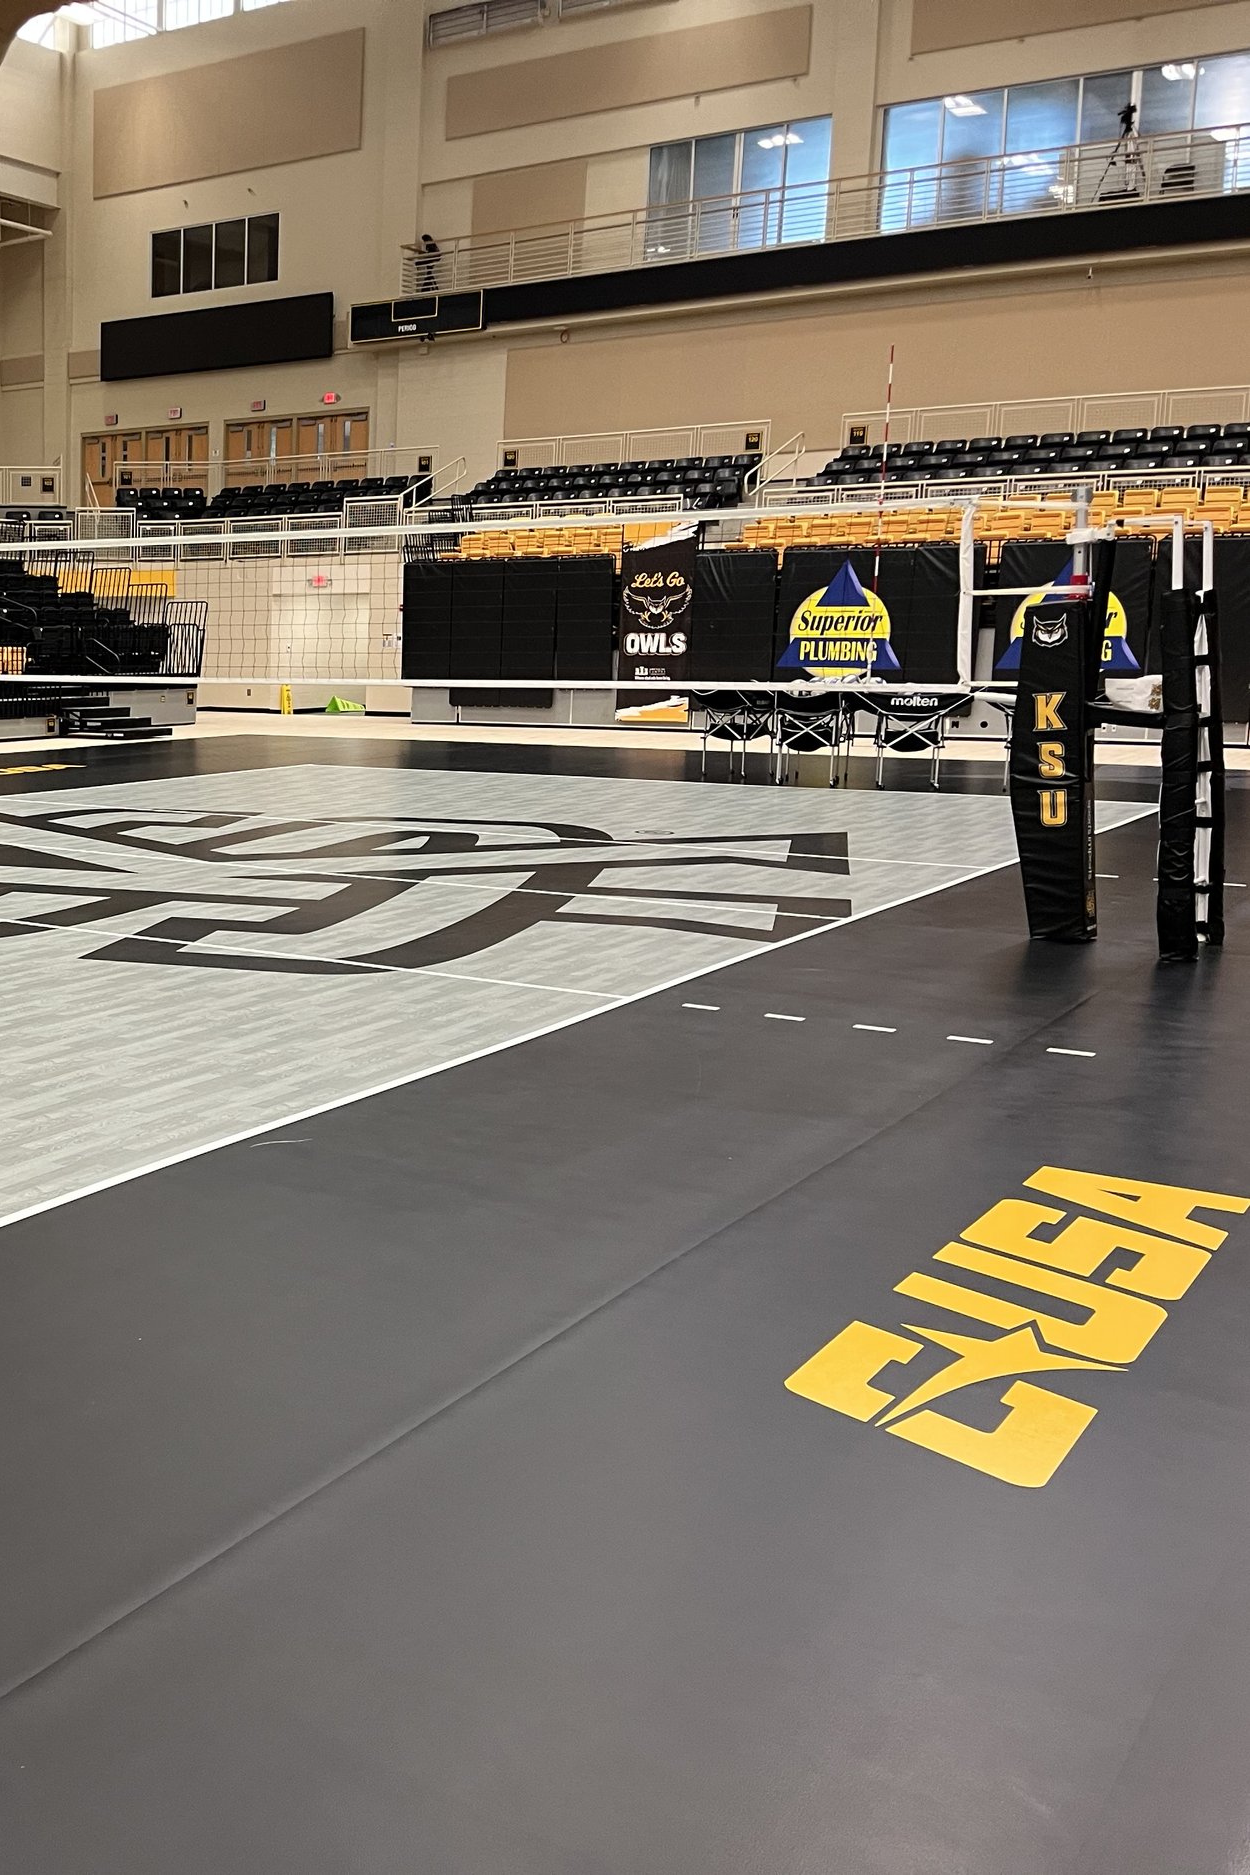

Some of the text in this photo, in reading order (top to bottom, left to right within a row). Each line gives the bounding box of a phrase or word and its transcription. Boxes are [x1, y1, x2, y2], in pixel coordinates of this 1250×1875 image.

[631, 571, 686, 588] Let's Go
[797, 609, 883, 636] Superior
[624, 631, 688, 656] OWLS
[800, 640, 878, 662] PLUMBING
[890, 695, 938, 707] molten
